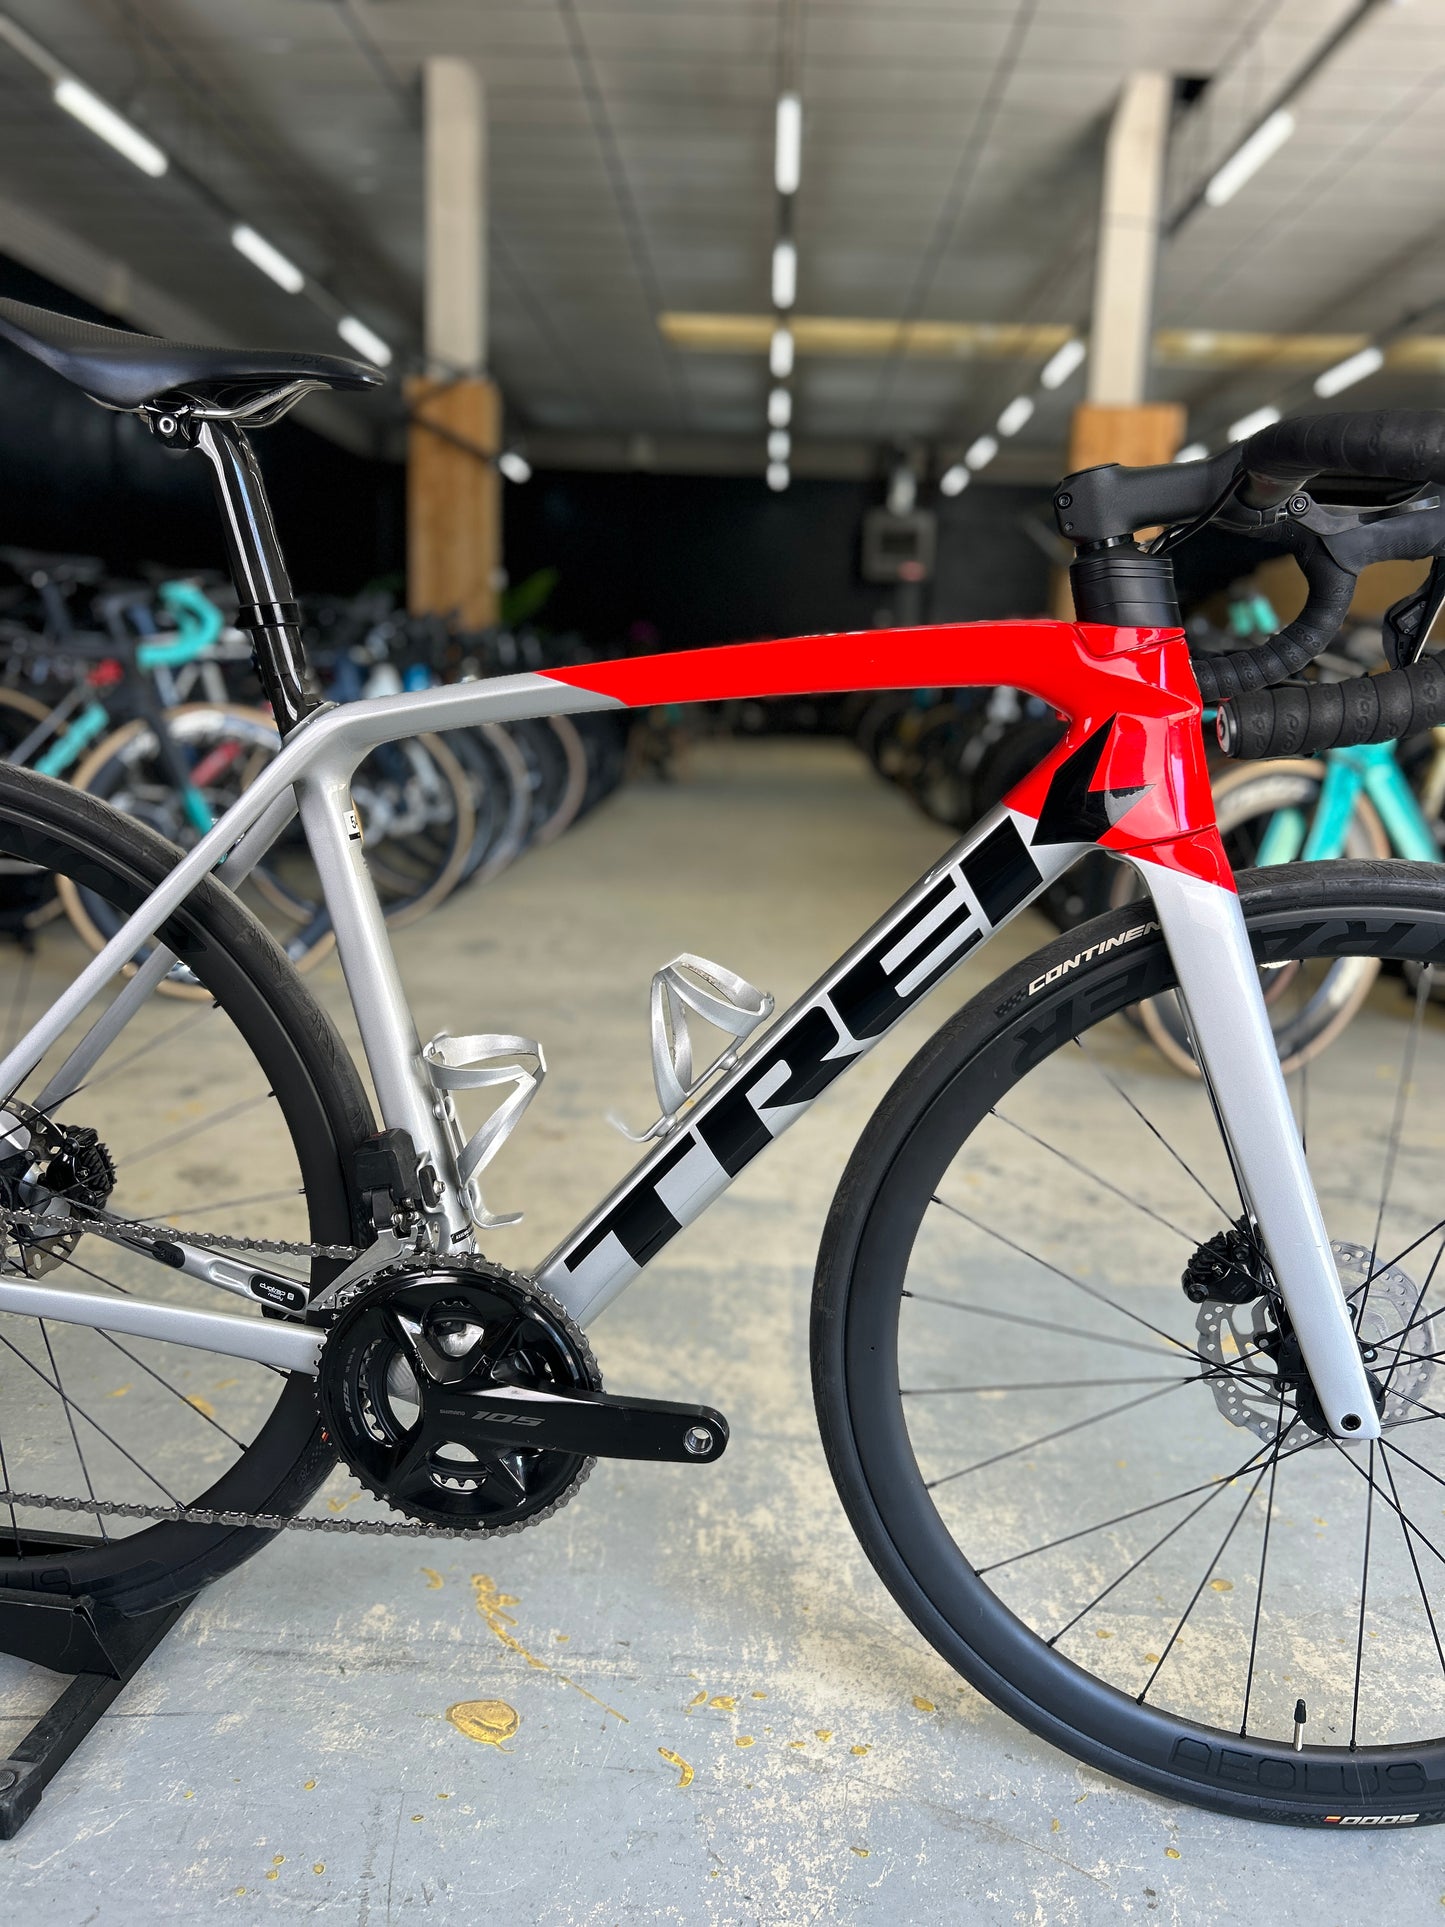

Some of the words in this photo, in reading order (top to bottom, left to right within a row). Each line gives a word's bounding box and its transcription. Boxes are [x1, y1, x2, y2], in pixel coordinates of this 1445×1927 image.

[1027, 921, 1162, 997] CONTINEN
[564, 714, 1155, 1273] TREK
[471, 1410, 546, 1427] 105
[1174, 1737, 1427, 1795] AEOLUS
[1339, 1813, 1420, 1826] 5000
